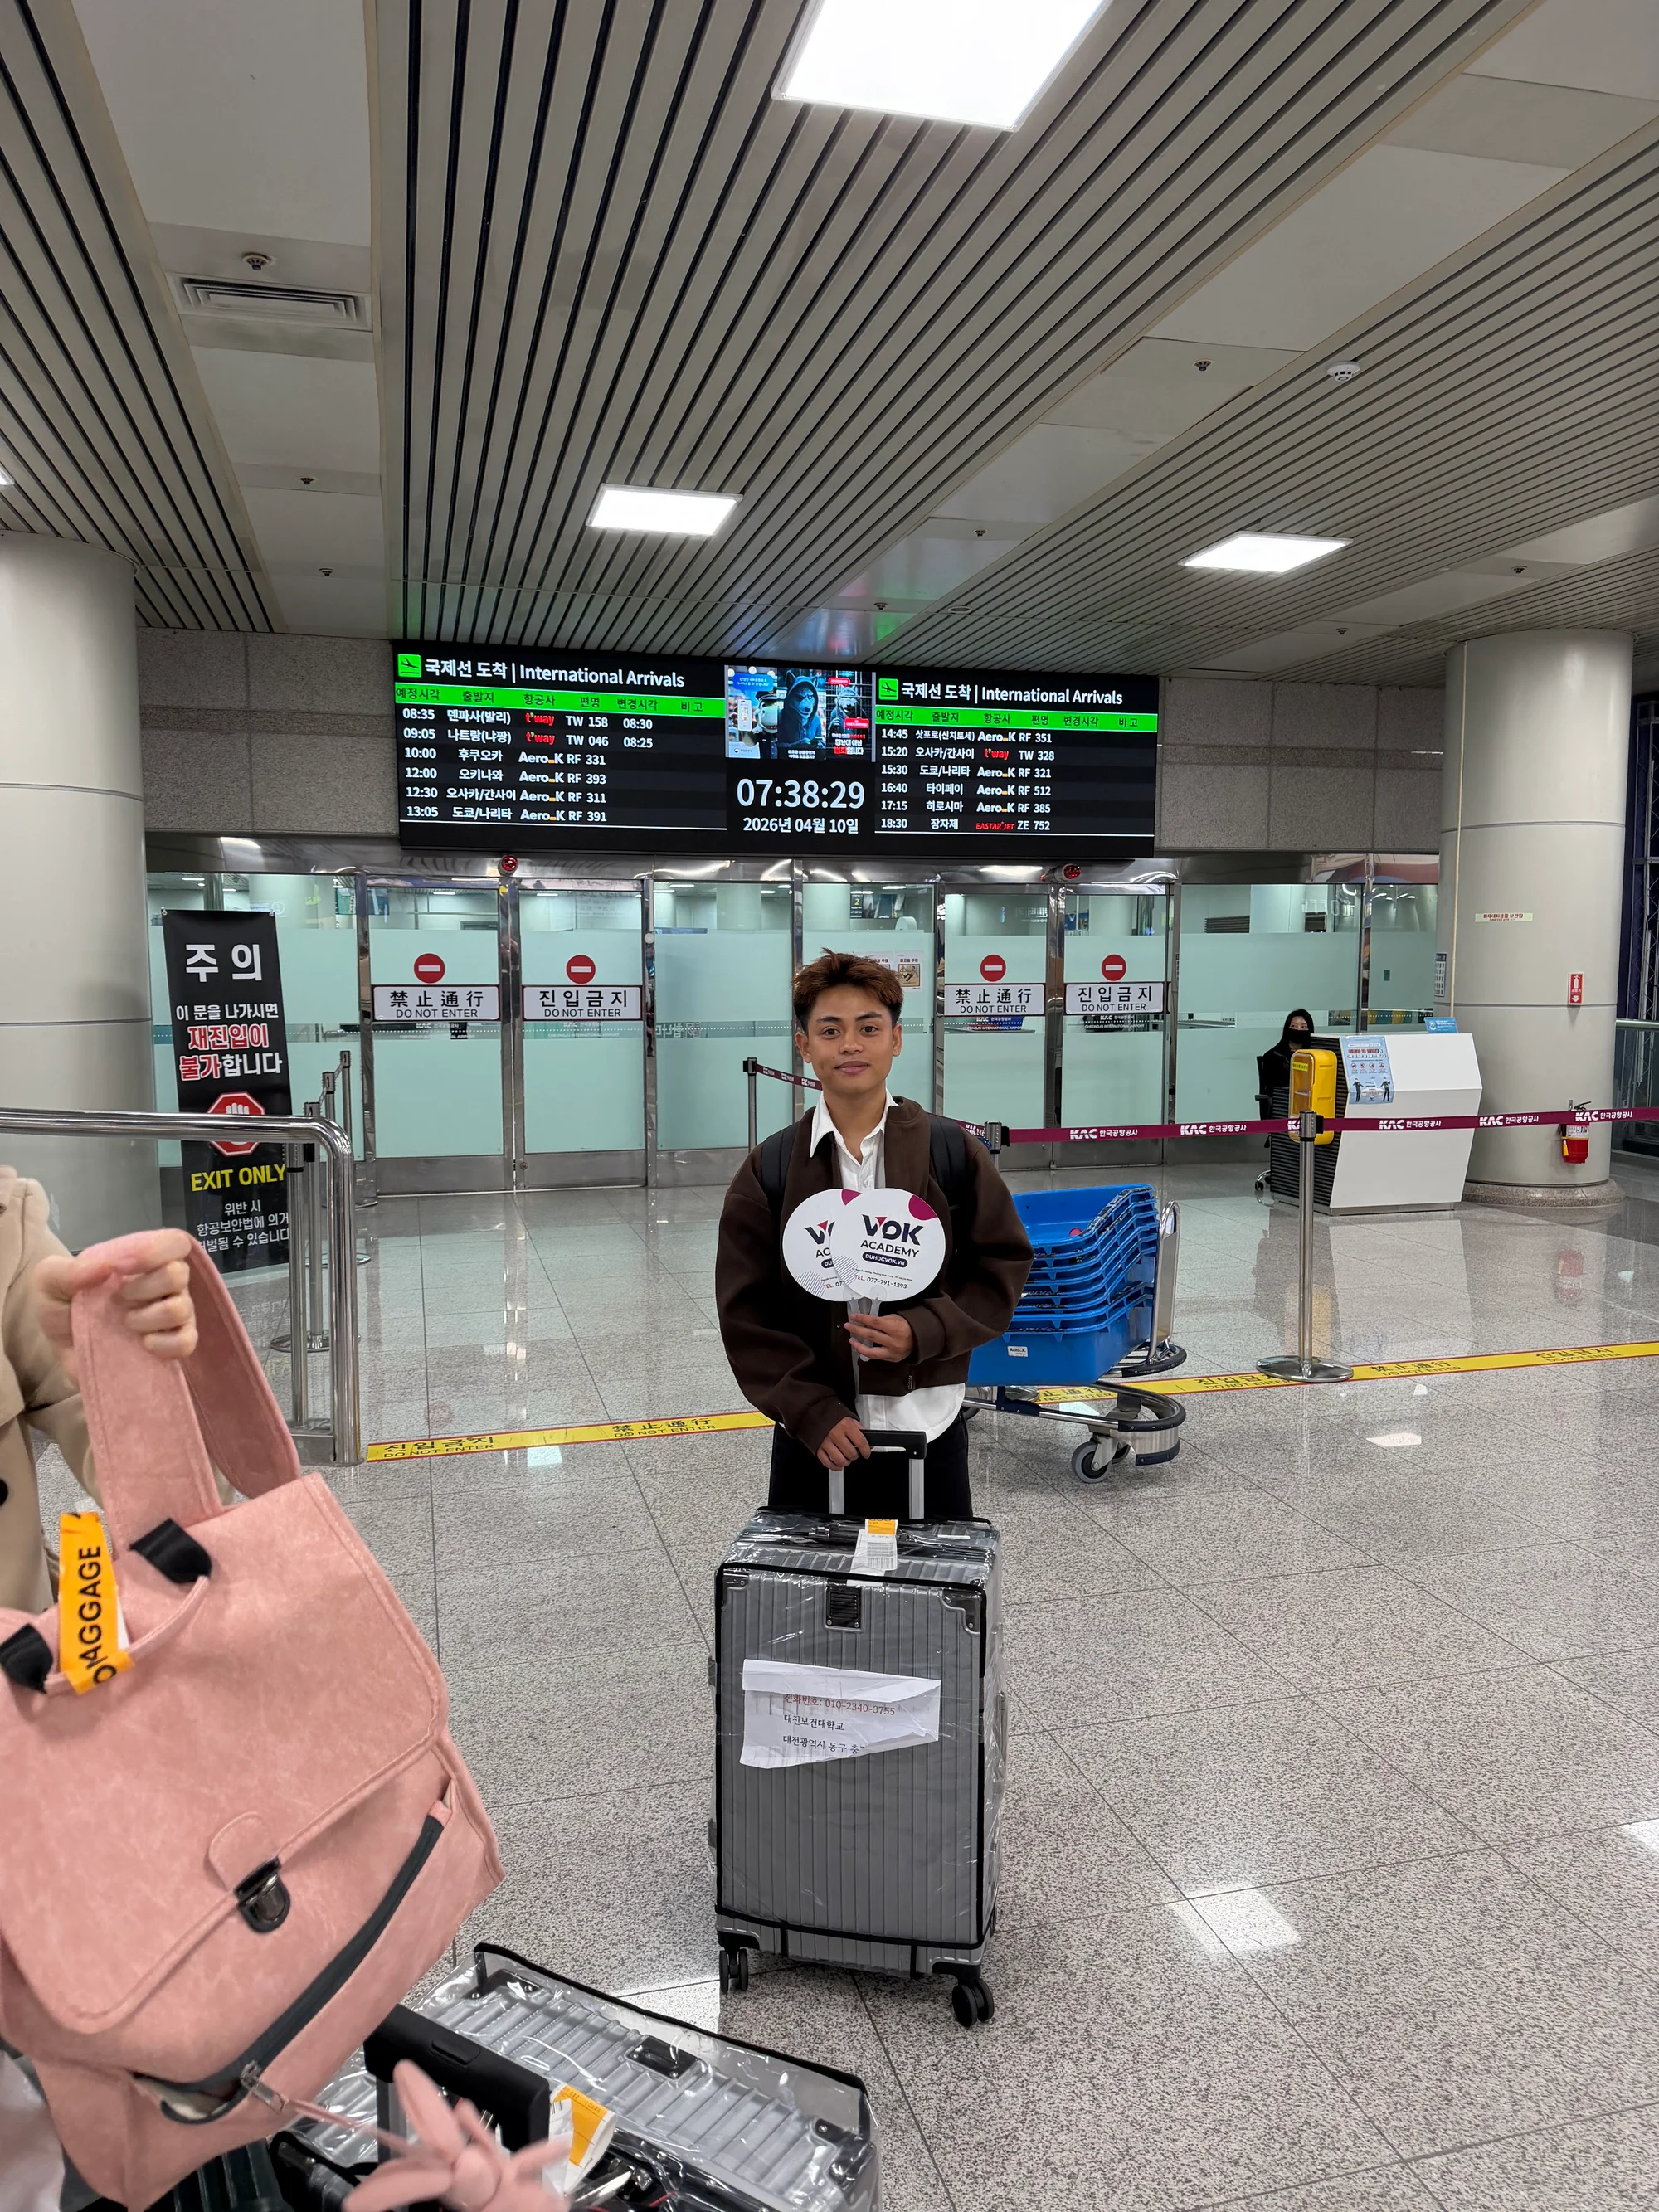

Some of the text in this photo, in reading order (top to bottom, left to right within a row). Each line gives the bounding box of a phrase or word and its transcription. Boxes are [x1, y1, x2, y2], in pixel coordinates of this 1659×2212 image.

[424, 659, 508, 680] 국제선 도착
[519, 664, 685, 688] International Arrivals
[396, 687, 440, 701] 예정시각
[462, 690, 495, 703] 출발지
[523, 693, 556, 706] 항공사
[580, 696, 601, 708] 편명
[616, 698, 659, 711] 변경시각
[901, 683, 971, 701] 국제선 도착
[981, 686, 1123, 705] International Arrivals
[402, 707, 435, 720] 08:35
[446, 709, 511, 726] 덴파사(발리)
[565, 715, 584, 727] TW
[588, 716, 609, 727] 158
[622, 718, 653, 730] 08:30
[876, 710, 913, 721] 예정시각
[932, 712, 959, 722] 출발지
[983, 713, 1011, 724] 항공사
[1031, 714, 1049, 726] 편명
[1063, 716, 1099, 727] 변경시각
[403, 727, 436, 739] 09:05
[566, 734, 584, 746] TW
[588, 736, 609, 746] 046
[623, 737, 654, 748] 08:25
[881, 728, 908, 739] 14:45
[915, 730, 975, 741] 삿포로(신치토세)
[1019, 732, 1031, 742] RF
[1034, 732, 1053, 743] 351
[405, 747, 437, 759] 10:00
[458, 748, 503, 762] 후쿠오카
[567, 753, 582, 765] RF
[586, 754, 606, 766] 331
[881, 746, 908, 756] 15:20
[915, 747, 975, 760] 오사카/간사이
[1019, 750, 1034, 761] TW
[1037, 751, 1055, 761] 328
[405, 767, 437, 779] 12:00
[458, 769, 504, 781] 오키나와
[567, 772, 582, 784] RF
[586, 773, 606, 785] 393
[881, 765, 908, 775] 15:30
[919, 765, 971, 777] 도쿄/나리타
[1018, 768, 1031, 778] RF
[1034, 768, 1052, 778] 321
[406, 786, 438, 798] 12:30
[446, 788, 516, 801] 오사카/간사이
[567, 791, 582, 803] RF
[586, 792, 606, 804] 311
[737, 778, 865, 809] 07:38:29
[881, 783, 908, 793] 16:40
[926, 783, 964, 795] 타이페이
[1018, 785, 1030, 795] RF
[1034, 785, 1052, 796] 512
[406, 805, 439, 817] 13:05
[452, 807, 513, 820] 도쿄/나리타
[568, 810, 583, 822] RF
[586, 811, 607, 823] 391
[881, 800, 908, 810] 17:15
[926, 800, 964, 813] 히로시마
[1018, 803, 1030, 813] RF
[1033, 803, 1051, 814] 385
[743, 817, 859, 834] 2026년 04월 10일
[881, 818, 907, 829] 18:30
[930, 818, 959, 830] 장자제
[1017, 820, 1029, 830] ZE
[1034, 821, 1051, 830] 752
[390, 990, 484, 1008] 禁止通行
[539, 990, 627, 1008] 진입금지
[956, 988, 1032, 1004] 禁止通行
[1078, 985, 1152, 1003] 진입금지
[176, 1003, 280, 1021] 이 문을 나가시면
[396, 1009, 479, 1018] DO NOT ENTER
[544, 1009, 621, 1018] DO NOT ENTER
[960, 1004, 1027, 1014] DO NOT ENTER
[1082, 1003, 1146, 1012] DO NOT ENTER
[187, 1023, 270, 1050] 재진입이
[180, 1052, 283, 1082] 불가합니다
[1379, 1119, 1442, 1130] KAC 한국공항공사
[1479, 1115, 1540, 1127] KAC 한국공항공사
[1575, 1111, 1632, 1121] KAC 한국공항공사
[1069, 1128, 1138, 1140] KAC 한국공항공사
[1180, 1124, 1247, 1136] KAC 한국공항공사
[191, 1163, 287, 1192] EXIT ONLY
[224, 1199, 261, 1216] 위반 시
[197, 1215, 265, 1237] 항공보안법에
[861, 1214, 924, 1246] VOK
[232, 1235, 245, 1248] 수
[860, 1239, 920, 1258] ACADEMY
[864, 1253, 906, 1266] DUHOCVOK.VN
[867, 1276, 907, 1289] 077-791-1293
[384, 1436, 494, 1452] 진입금지
[78, 1546, 102, 1660] AGGAGE
[825, 1699, 896, 1716] 010-2340-3755
[784, 1714, 844, 1731] 대전보건대학교
[782, 1735, 825, 1749] 대전광역시
[828, 1742, 847, 1753] 동구
